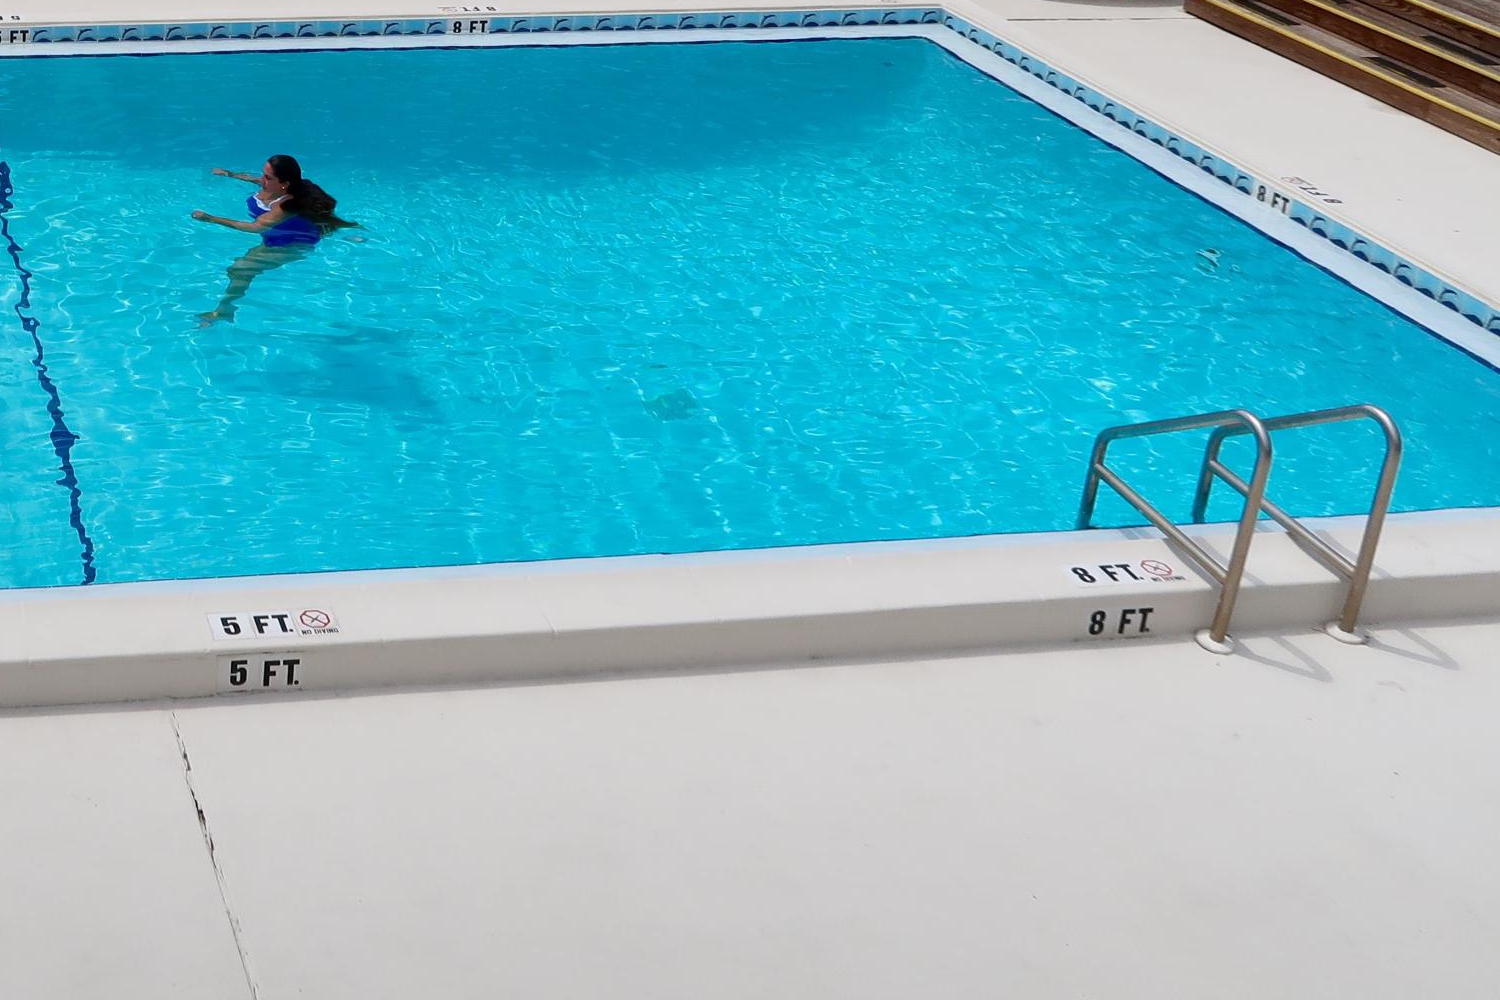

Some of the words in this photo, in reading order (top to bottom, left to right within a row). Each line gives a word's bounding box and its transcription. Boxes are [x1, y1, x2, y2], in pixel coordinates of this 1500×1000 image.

[10, 30, 29, 43] FT
[453, 21, 462, 33] 8
[469, 21, 488, 33] FT
[1257, 185, 1266, 202] 8
[1271, 193, 1290, 213] FT
[1071, 567, 1096, 583] 8
[1098, 564, 1144, 582] FT.
[220, 617, 241, 636] 5
[253, 614, 294, 634] FT.
[1088, 610, 1106, 635] 8
[1117, 608, 1154, 634] FT.
[230, 660, 248, 686] 5
[263, 659, 300, 687] FT.
